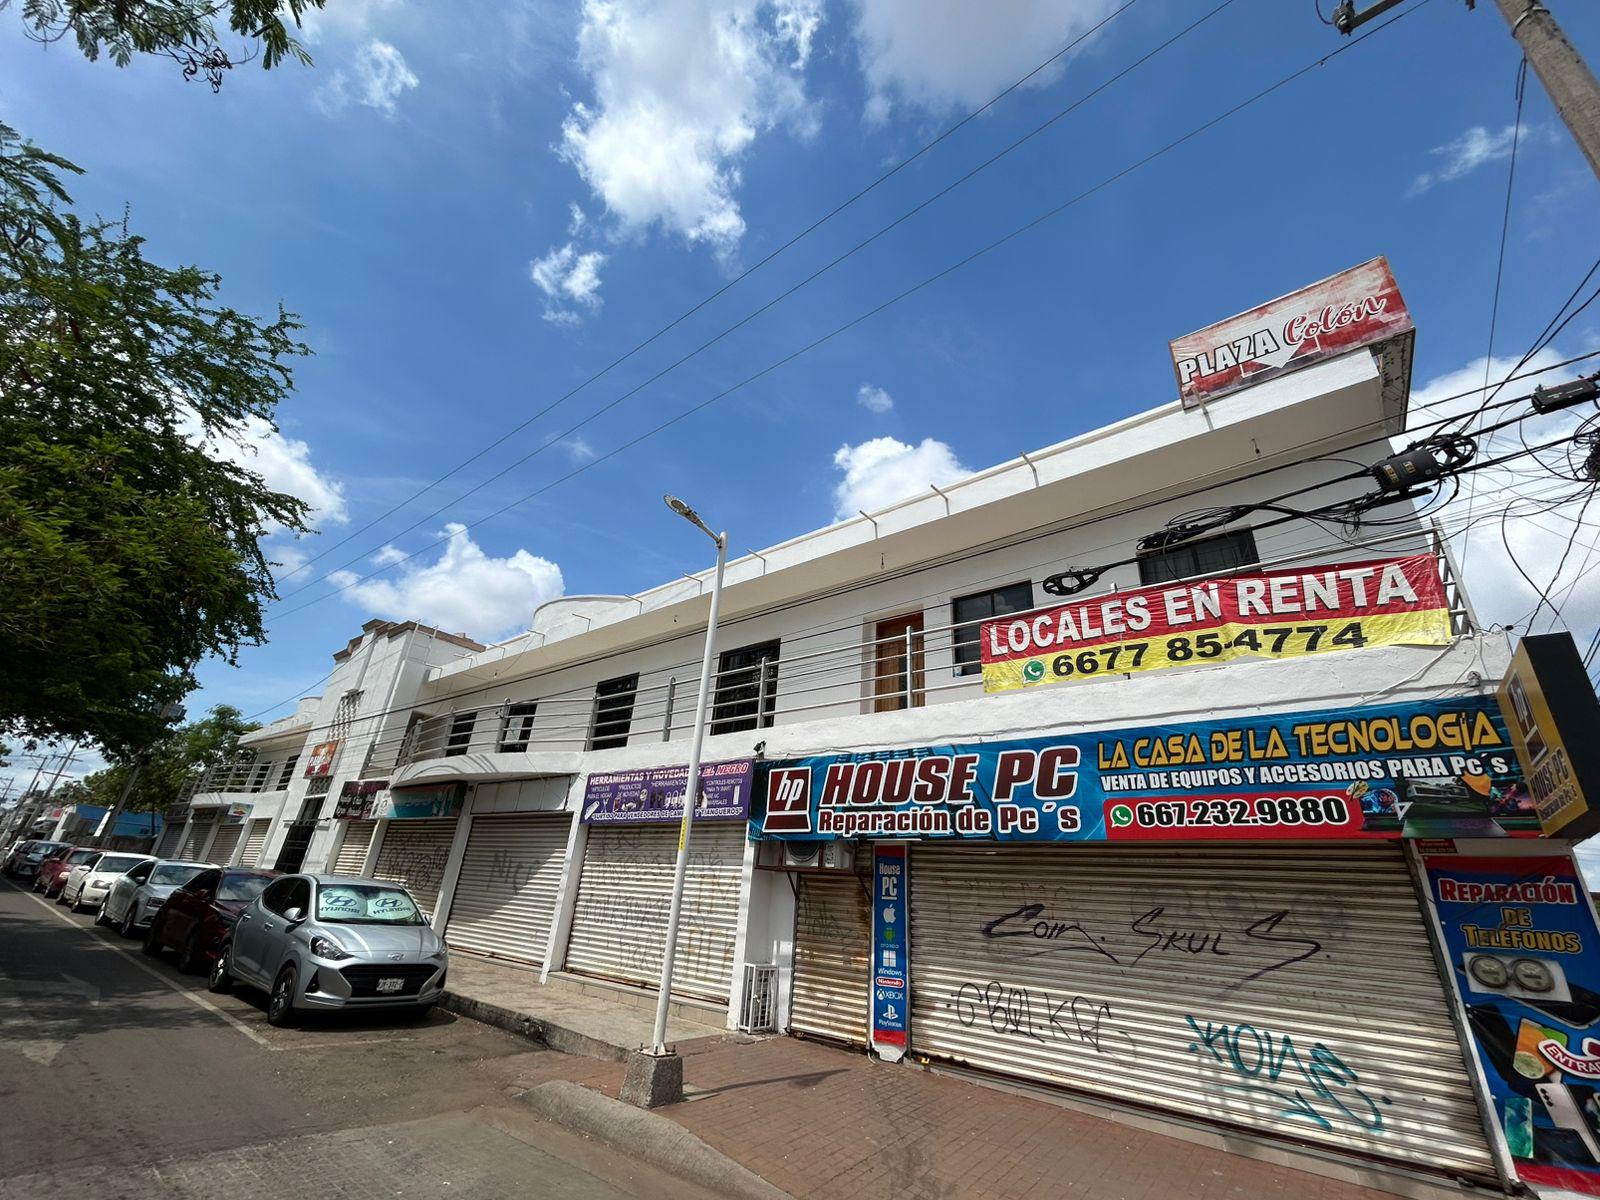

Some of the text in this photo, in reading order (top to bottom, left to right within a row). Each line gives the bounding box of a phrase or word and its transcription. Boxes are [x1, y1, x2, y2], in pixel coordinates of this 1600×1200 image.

[1178, 295, 1388, 384] PLAZA Colón
[988, 563, 1419, 656] LOCALES EN RENTA
[1052, 642, 1149, 677] 6677
[1098, 740, 1130, 770] LA
[1134, 733, 1206, 767] CASA
[1211, 729, 1244, 762] DE
[1248, 726, 1289, 760] LA
[590, 771, 645, 785] HERRAMIENTAS
[645, 771, 652, 781] Y
[715, 762, 749, 776] NEGRO
[819, 745, 1081, 807] HOUSE PC
[1100, 772, 1149, 791] VENTA
[1150, 772, 1170, 789] DE
[1171, 768, 1243, 790] EQUIPOS
[1243, 766, 1256, 785] Y
[1260, 759, 1386, 785] ACCESORIOS
[1387, 756, 1450, 779] PARA
[1529, 759, 1558, 806] HOUSE
[1550, 746, 1570, 786] PC
[775, 771, 805, 811] hp
[817, 805, 951, 837] Reparación
[955, 804, 992, 833] de
[1137, 795, 1350, 828] 667.232.9880
[881, 875, 898, 897] PC
[1437, 875, 1578, 905] REPARACIÓN
[373, 906, 411, 915] HYUNDAI
[1501, 906, 1532, 928] DE
[878, 967, 903, 977] Windows
[878, 978, 902, 987] Nintendo
[884, 990, 904, 1000] XBOX
